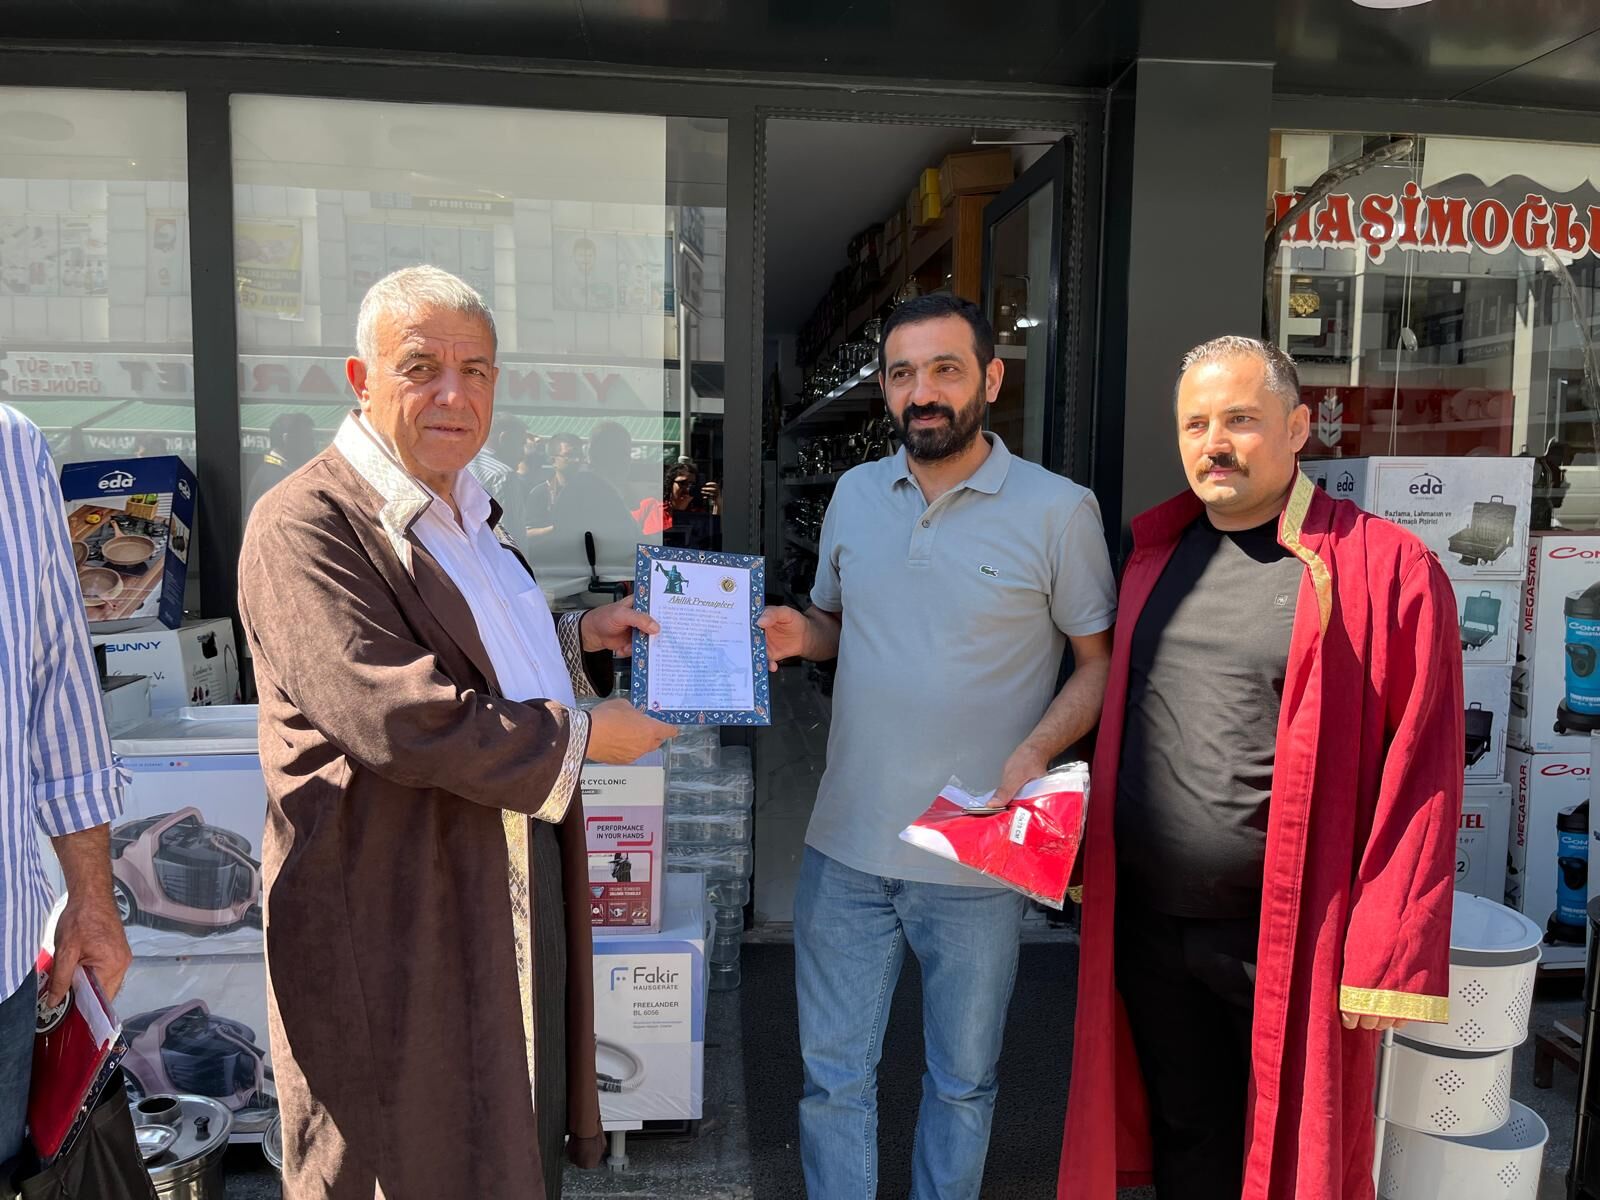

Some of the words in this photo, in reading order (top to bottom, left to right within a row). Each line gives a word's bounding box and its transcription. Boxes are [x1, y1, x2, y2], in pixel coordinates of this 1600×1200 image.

[98, 475, 134, 490] eda
[1337, 476, 1354, 492] eda
[1409, 478, 1443, 495] eda
[1524, 545, 1538, 634] MEGASTAR
[104, 641, 162, 653] SUNNY
[587, 778, 627, 786] CYCLONIC
[1516, 764, 1528, 848] MEGASTAR
[1458, 814, 1486, 829] TEL
[633, 966, 679, 984] Fakir
[633, 1001, 679, 1009] FREELANDER
